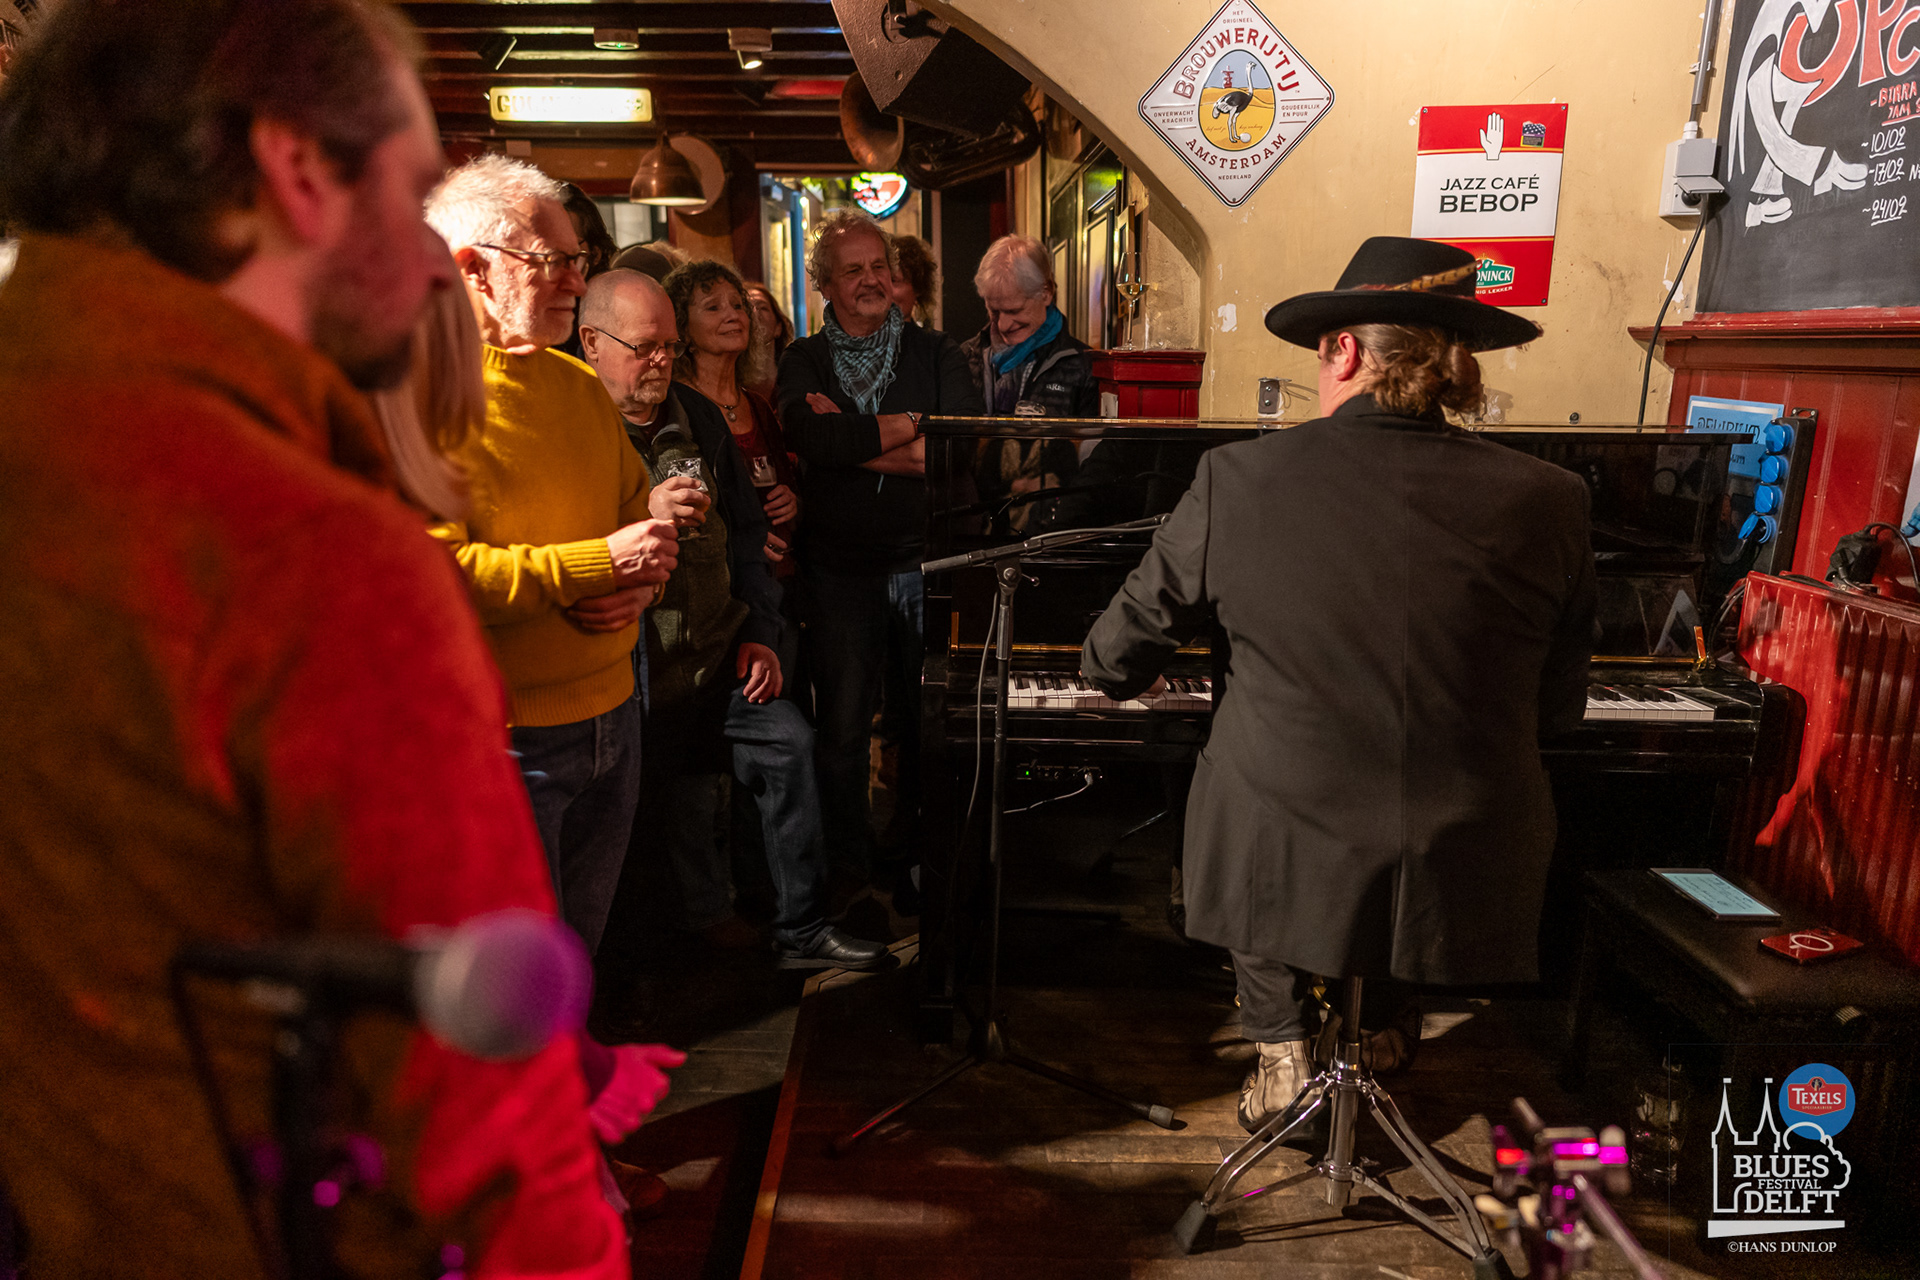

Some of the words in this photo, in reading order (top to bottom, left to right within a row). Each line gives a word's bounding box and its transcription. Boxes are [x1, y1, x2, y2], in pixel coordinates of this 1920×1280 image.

[1153, 110, 1194, 118] ONVERWACHT
[1185, 133, 1287, 170] AMSTERDAM
[1439, 177, 1487, 191] JAZZ
[1491, 173, 1540, 190] CAFÉ
[1439, 193, 1539, 214] BEBOP
